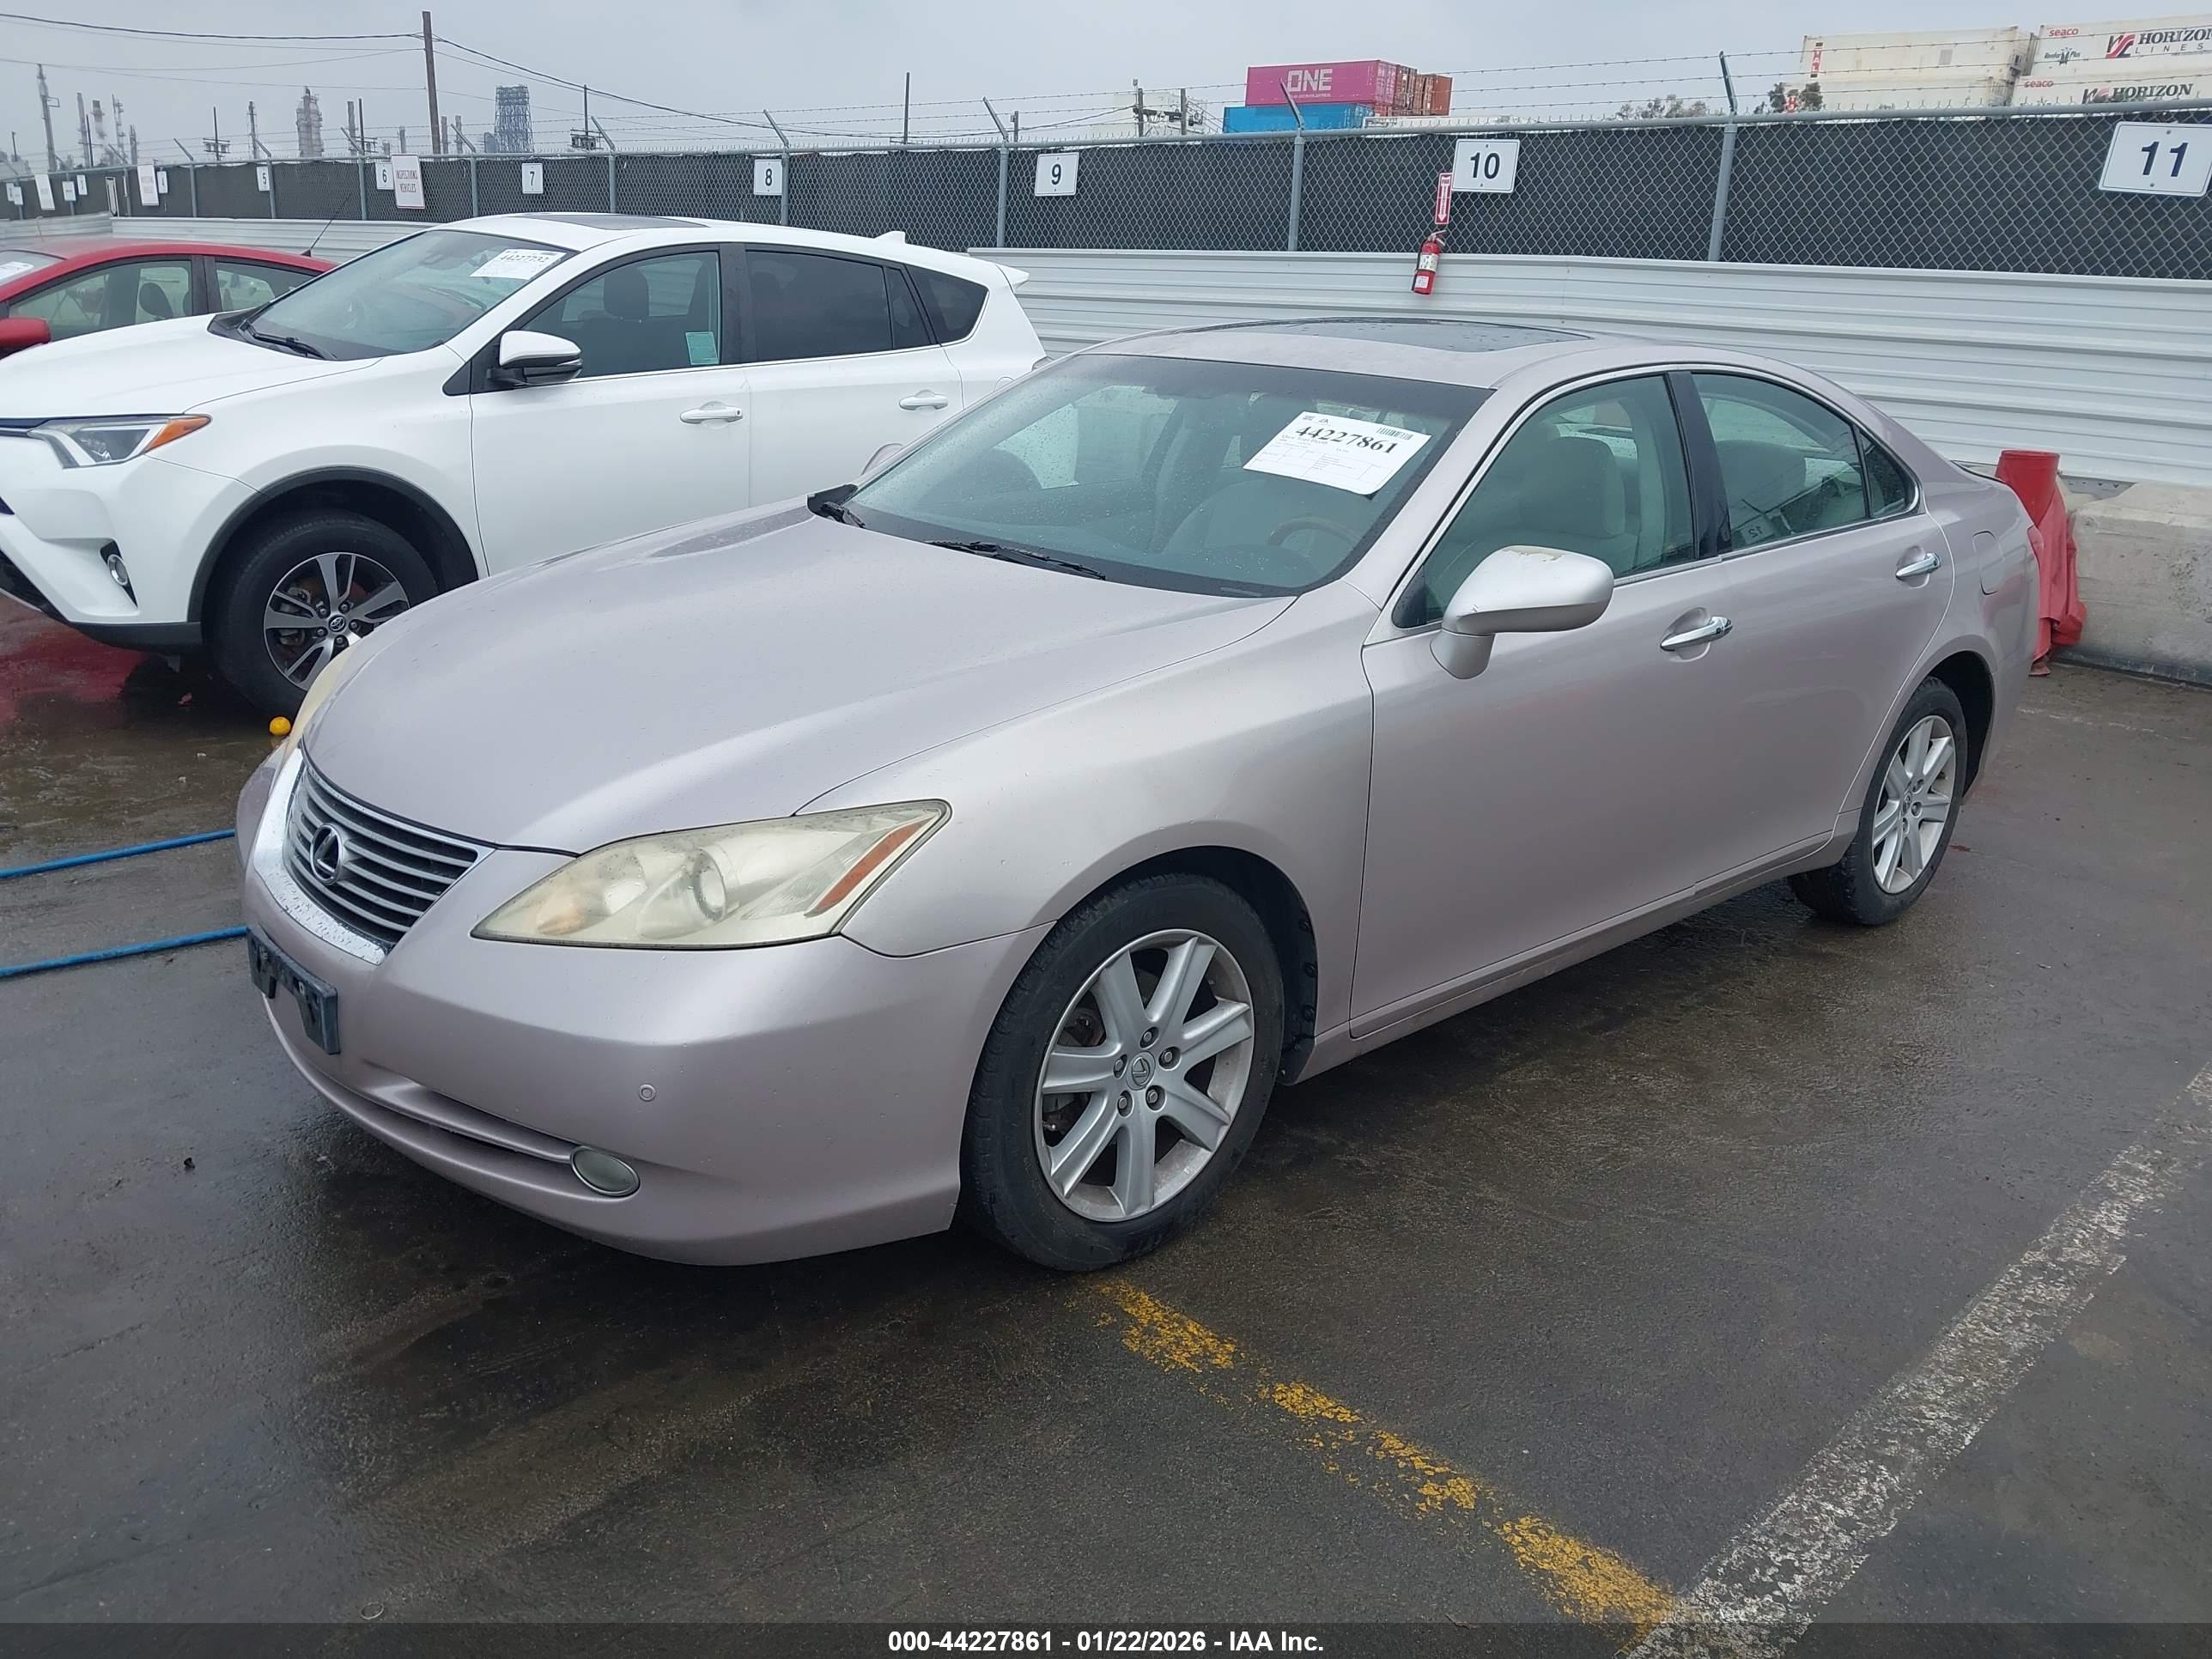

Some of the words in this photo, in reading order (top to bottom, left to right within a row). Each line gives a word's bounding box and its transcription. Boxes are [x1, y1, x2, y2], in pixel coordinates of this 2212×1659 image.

[2048, 28, 2079, 37] seaco
[2135, 42, 2204, 54] LINES
[1288, 68, 1333, 92] ONE
[2112, 84, 2193, 99] HORIZON
[1470, 152, 1500, 179] 10
[2141, 141, 2189, 177] 11
[262, 172, 267, 185] 5
[382, 169, 387, 183] 6
[529, 171, 536, 186] 7
[764, 168, 773, 186] 8
[1051, 163, 1062, 185] 9
[1295, 426, 1399, 454] 44227861
